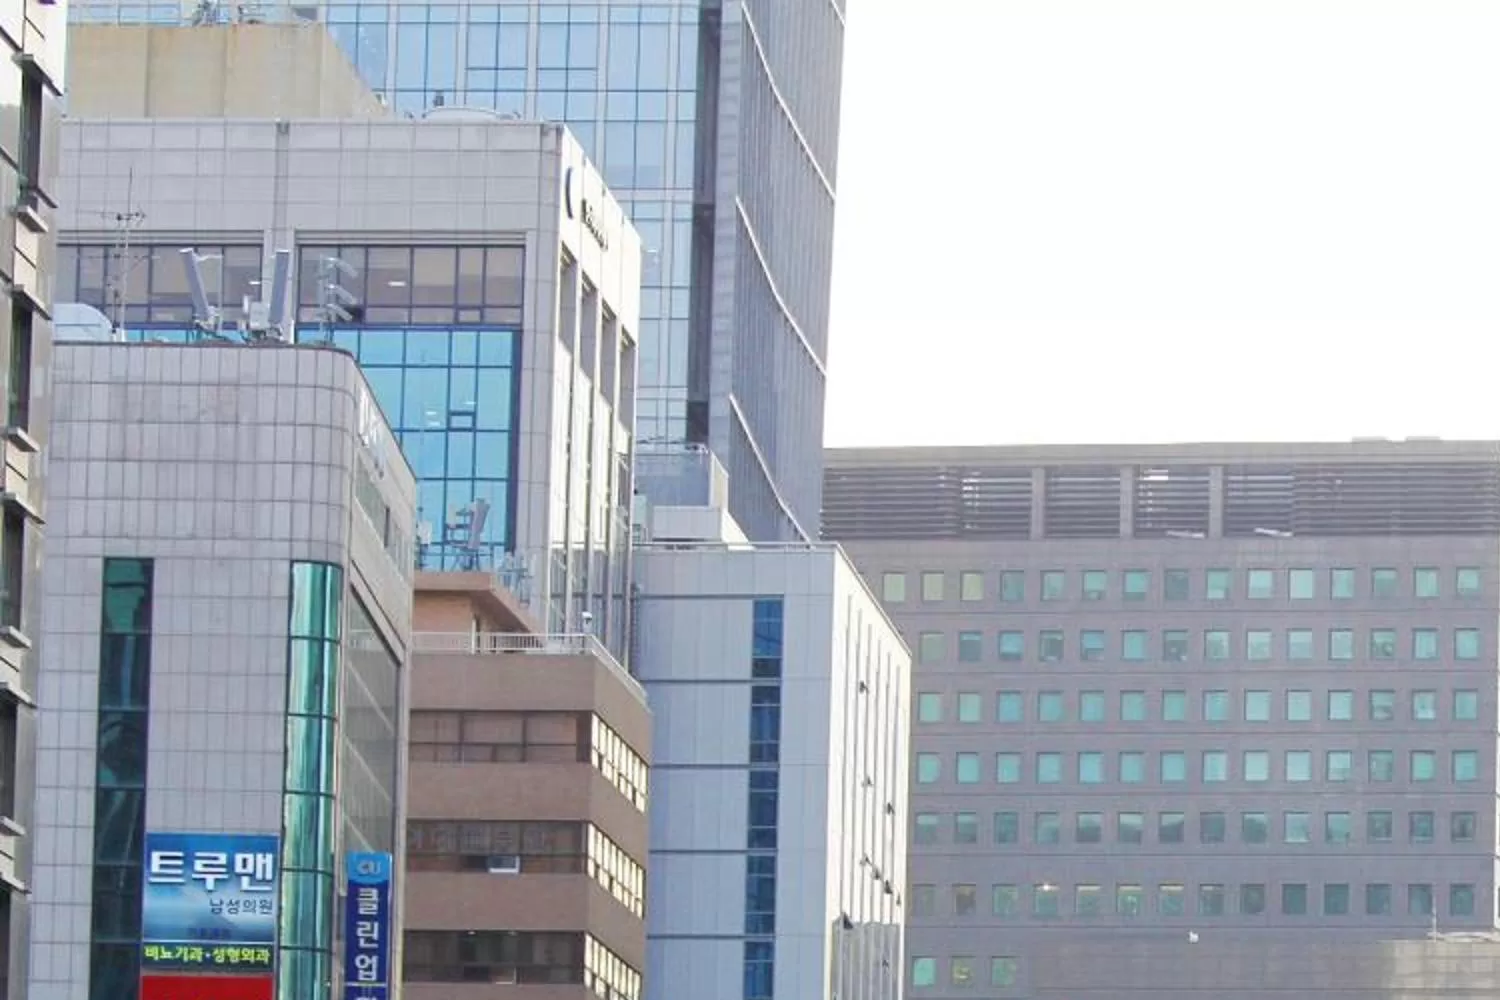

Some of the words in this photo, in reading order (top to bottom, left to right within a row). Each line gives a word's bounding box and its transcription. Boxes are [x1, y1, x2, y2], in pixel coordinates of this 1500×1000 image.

[148, 851, 274, 891] 트루맨
[209, 899, 273, 915] 남성의원
[354, 887, 380, 982] 클린업
